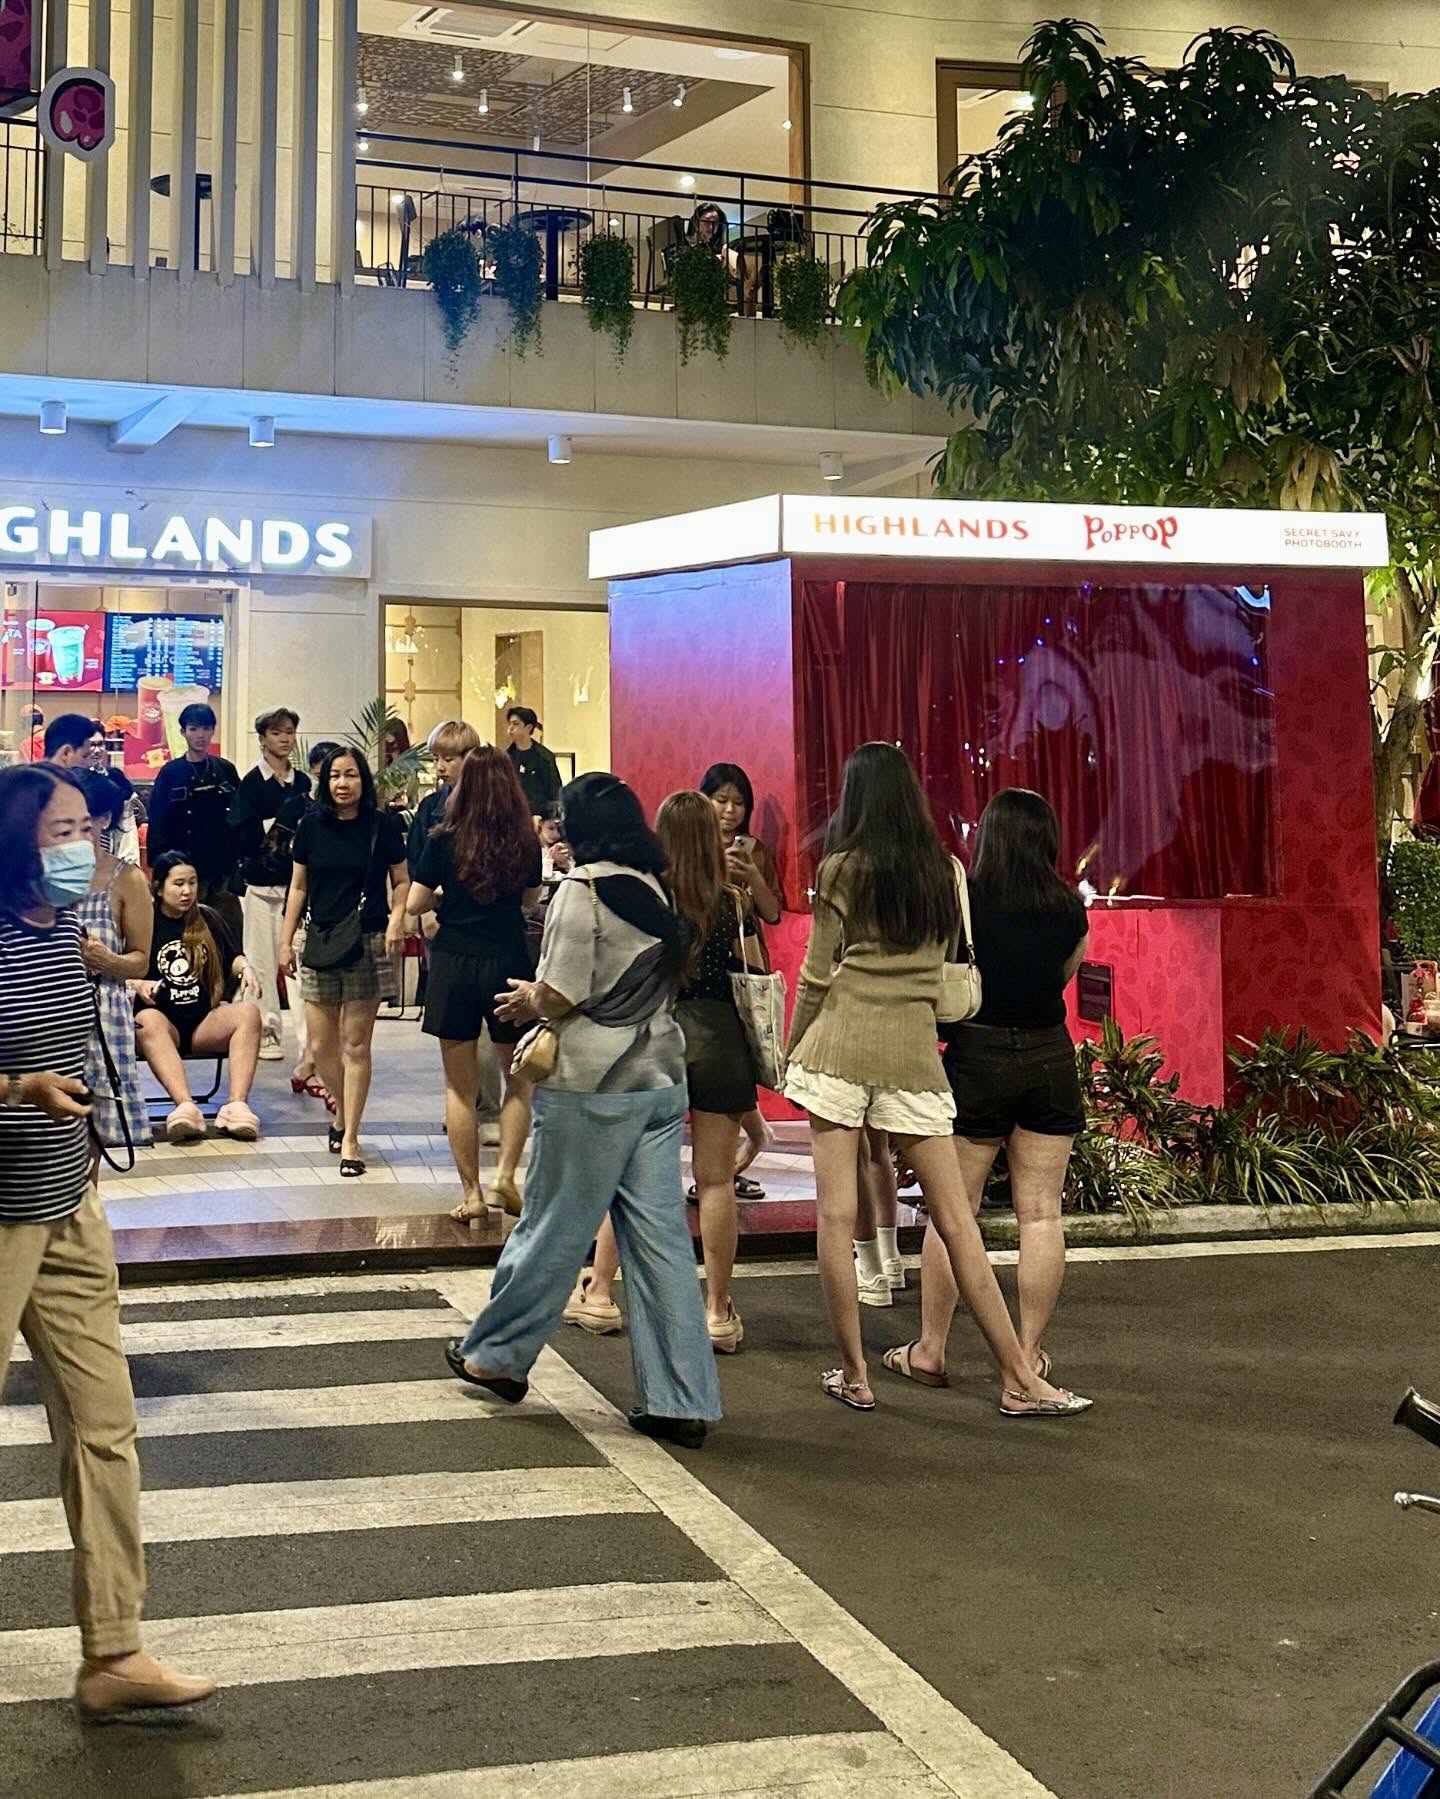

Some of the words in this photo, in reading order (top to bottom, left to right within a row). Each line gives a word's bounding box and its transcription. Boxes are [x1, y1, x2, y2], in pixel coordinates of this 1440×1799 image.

[814, 512, 1029, 540] HIGHLANDS
[1284, 528, 1327, 537] SECRET
[1331, 529, 1360, 538] SAVY
[0, 506, 353, 568] GHLANDS
[1284, 538, 1362, 549] PHOTOBOOTH
